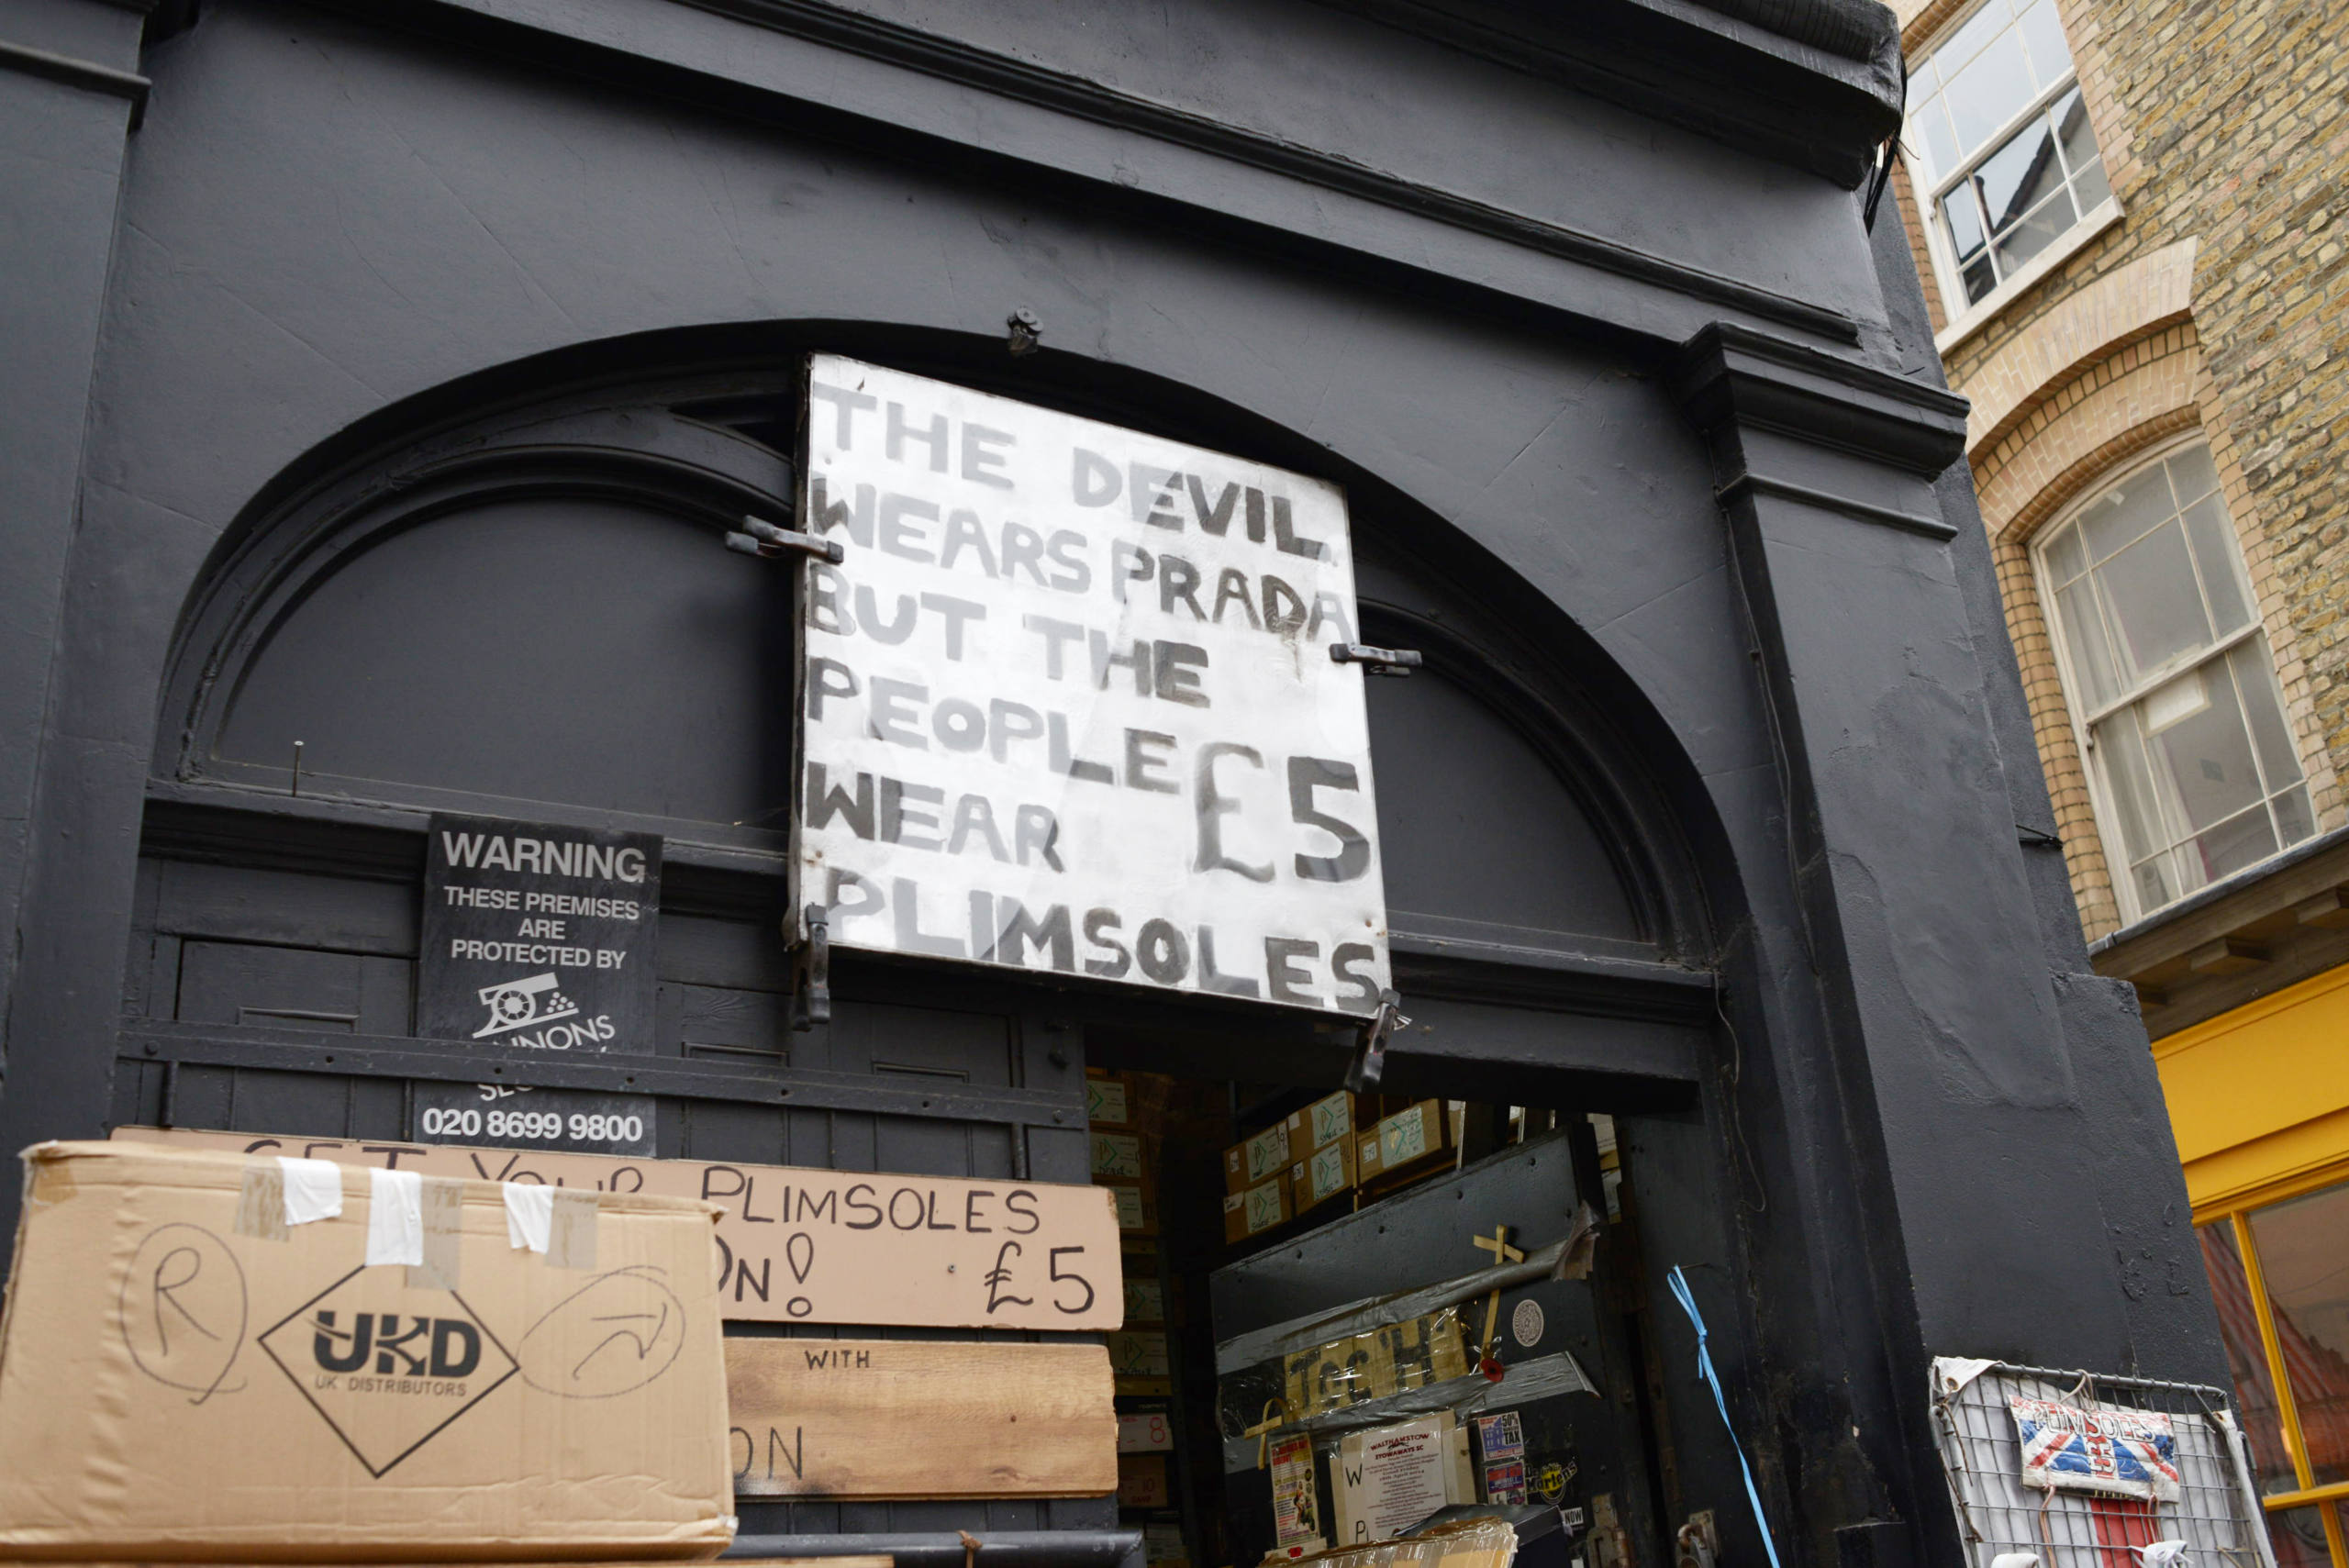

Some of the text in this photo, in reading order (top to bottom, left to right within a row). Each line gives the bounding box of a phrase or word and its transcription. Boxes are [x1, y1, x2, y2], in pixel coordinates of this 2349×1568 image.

[814, 382, 1331, 561] THE DEVIL
[811, 477, 1354, 642] WEARS PRADA
[808, 562, 1210, 708] BUT THE
[808, 655, 1371, 883] PEOPLE £5
[807, 761, 1065, 873] WEAR
[441, 831, 646, 884] WARNING
[444, 885, 640, 920] THESE PREMISES
[518, 918, 565, 940] ARE
[826, 867, 1379, 1015] PLIMSOLES
[451, 939, 627, 969] PROTECTED BY
[422, 1108, 642, 1142] 020 8699 9800
[701, 1165, 1040, 1234] PLIMSOLES
[984, 1240, 1095, 1314] £5
[805, 1350, 870, 1371] WITH
[315, 1376, 466, 1397] UK DISTRIBUTORS
[1370, 1433, 1430, 1451] WALTHAMSTOW
[1504, 1431, 1521, 1445] TAX
[2032, 1404, 2156, 1444] PLIMSOLES
[2086, 1441, 2116, 1473] £5
[1564, 1509, 1582, 1524] NOW
